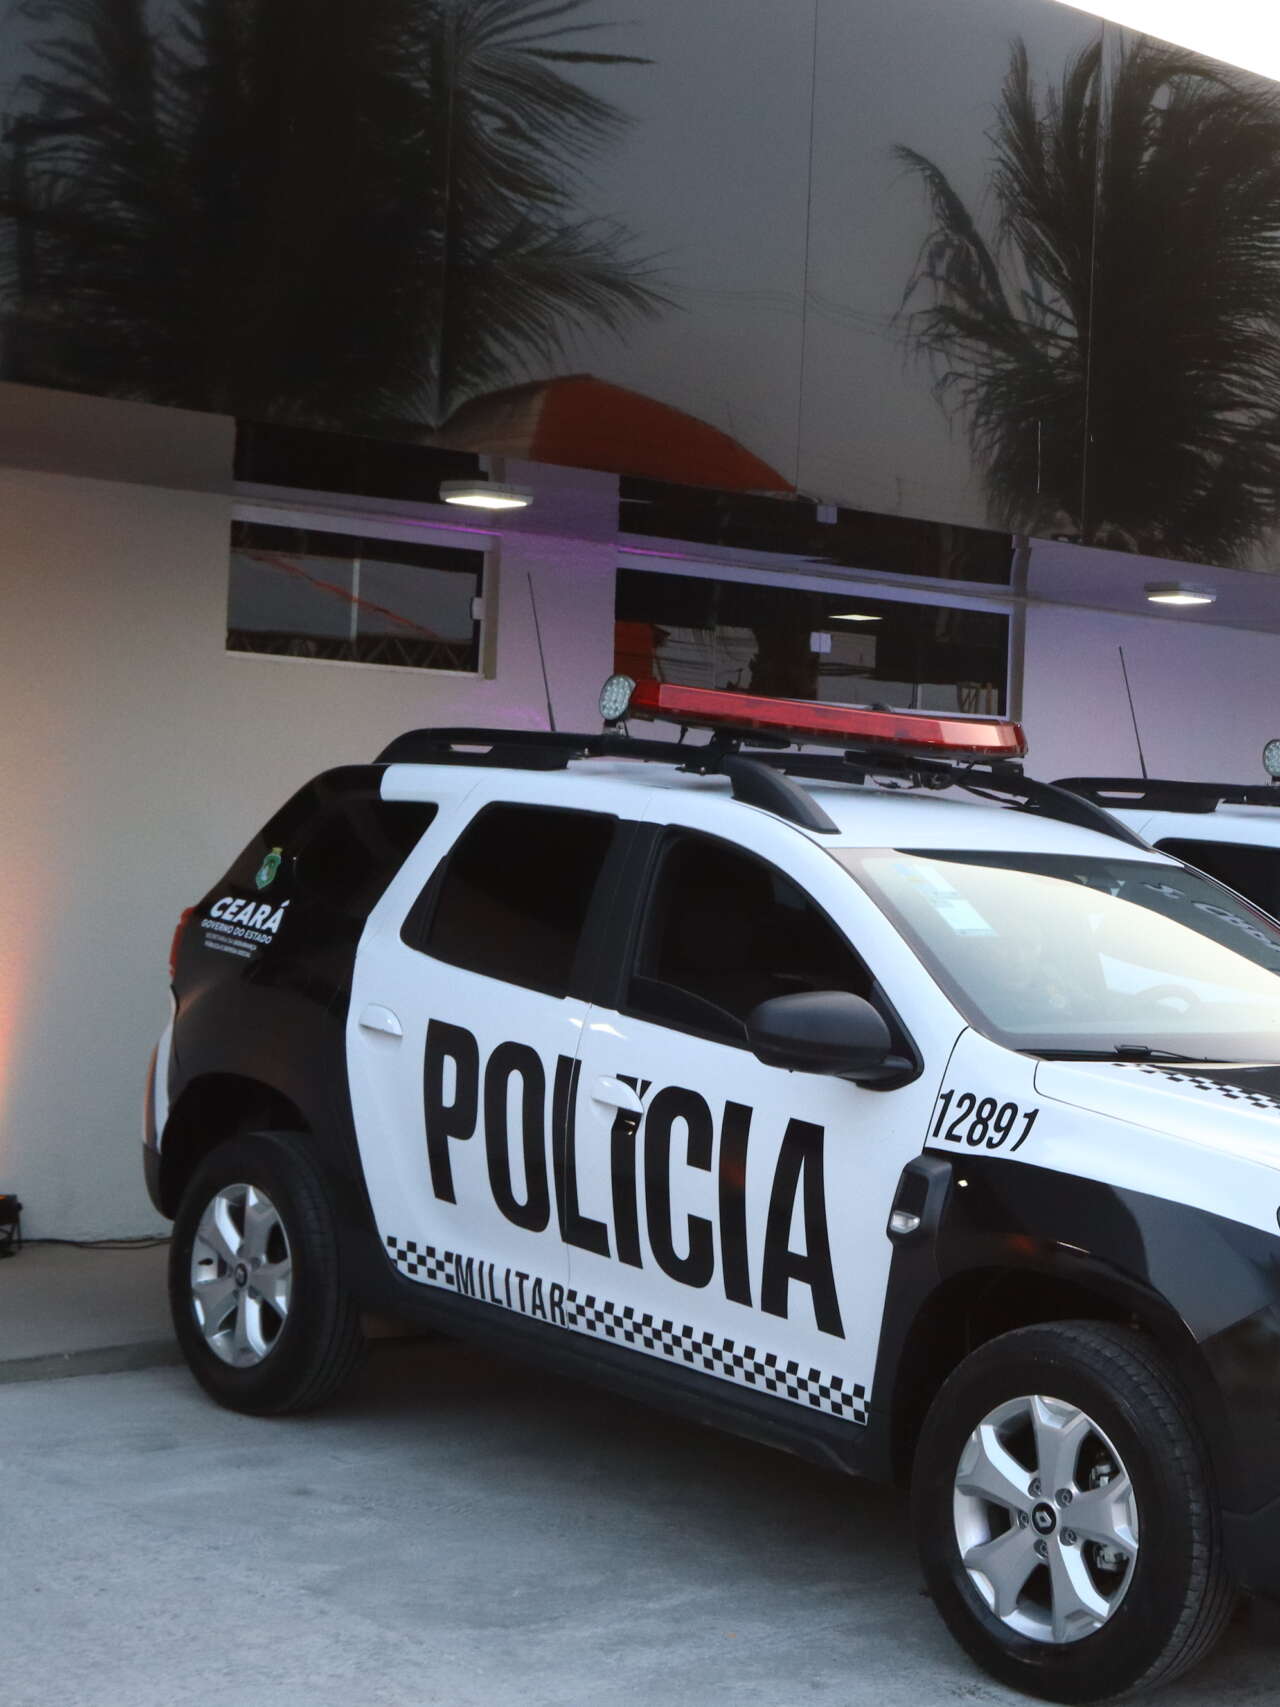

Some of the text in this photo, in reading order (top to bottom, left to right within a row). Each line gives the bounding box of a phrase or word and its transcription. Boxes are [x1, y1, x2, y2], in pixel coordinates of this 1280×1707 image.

[209, 896, 290, 933] CEARÁ
[932, 1089, 1040, 1152] 12891
[423, 1018, 846, 1340] POLÍCIA
[454, 1253, 566, 1327] MILITAR
